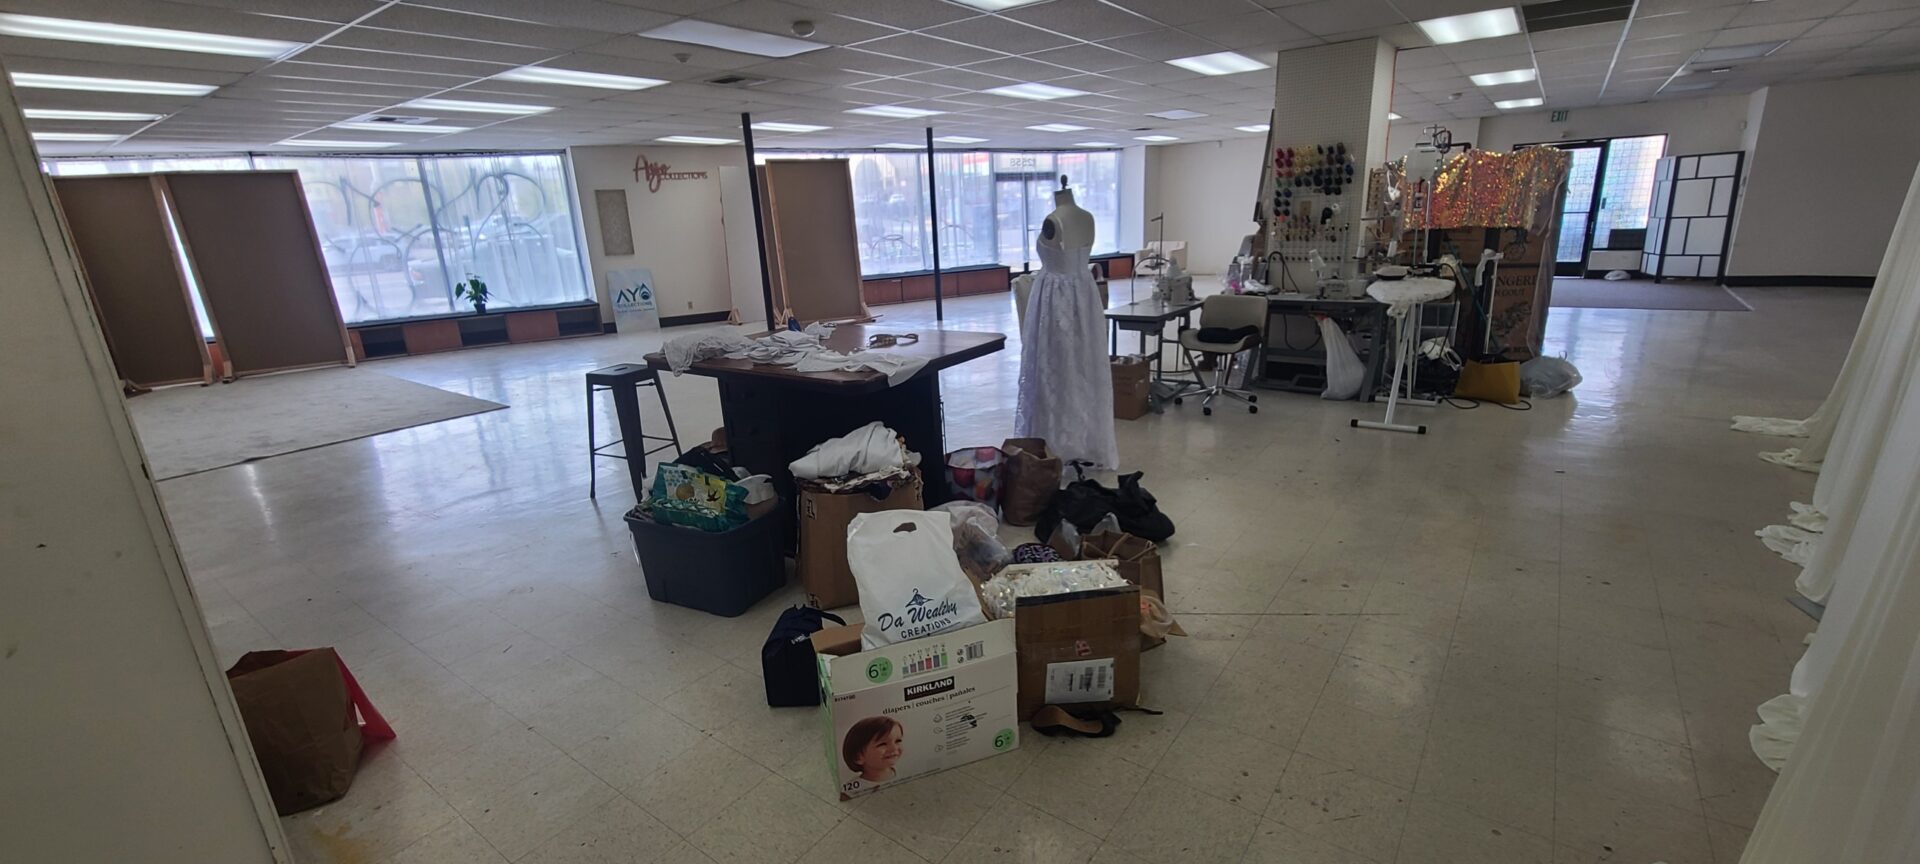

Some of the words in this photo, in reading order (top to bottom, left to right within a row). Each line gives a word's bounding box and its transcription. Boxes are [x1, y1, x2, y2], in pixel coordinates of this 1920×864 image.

[1551, 110, 1569, 122] EXIT
[877, 612, 904, 632] Da
[907, 597, 958, 624] Wealthy
[900, 617, 951, 639] CREATIONS
[869, 664, 879, 679] 6
[906, 678, 953, 696] KIRKLAND
[882, 703, 911, 715] diapers
[915, 695, 945, 708] couches
[994, 735, 1004, 748] 6
[843, 780, 860, 791] 120
